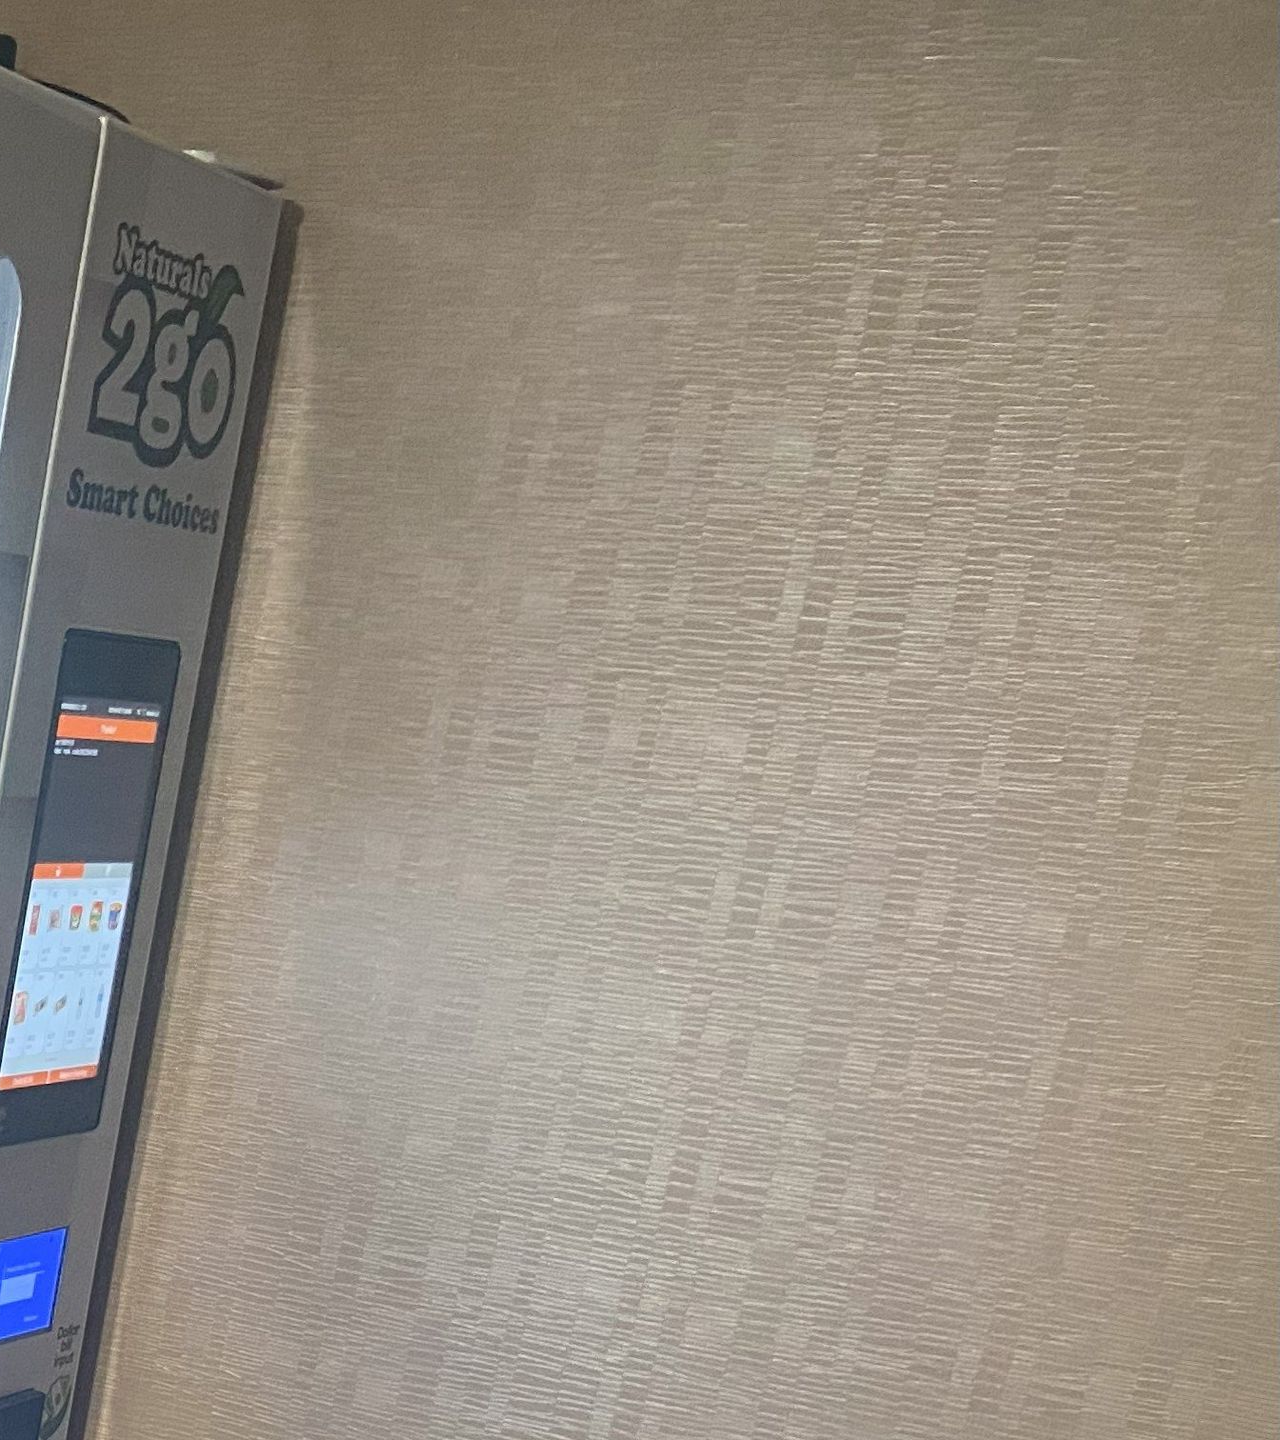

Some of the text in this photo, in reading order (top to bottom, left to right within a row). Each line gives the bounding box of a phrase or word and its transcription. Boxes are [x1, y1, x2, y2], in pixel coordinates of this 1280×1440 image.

[113, 221, 212, 299] Naturals
[87, 268, 237, 468] 2go
[66, 467, 221, 535] Smart Choices
